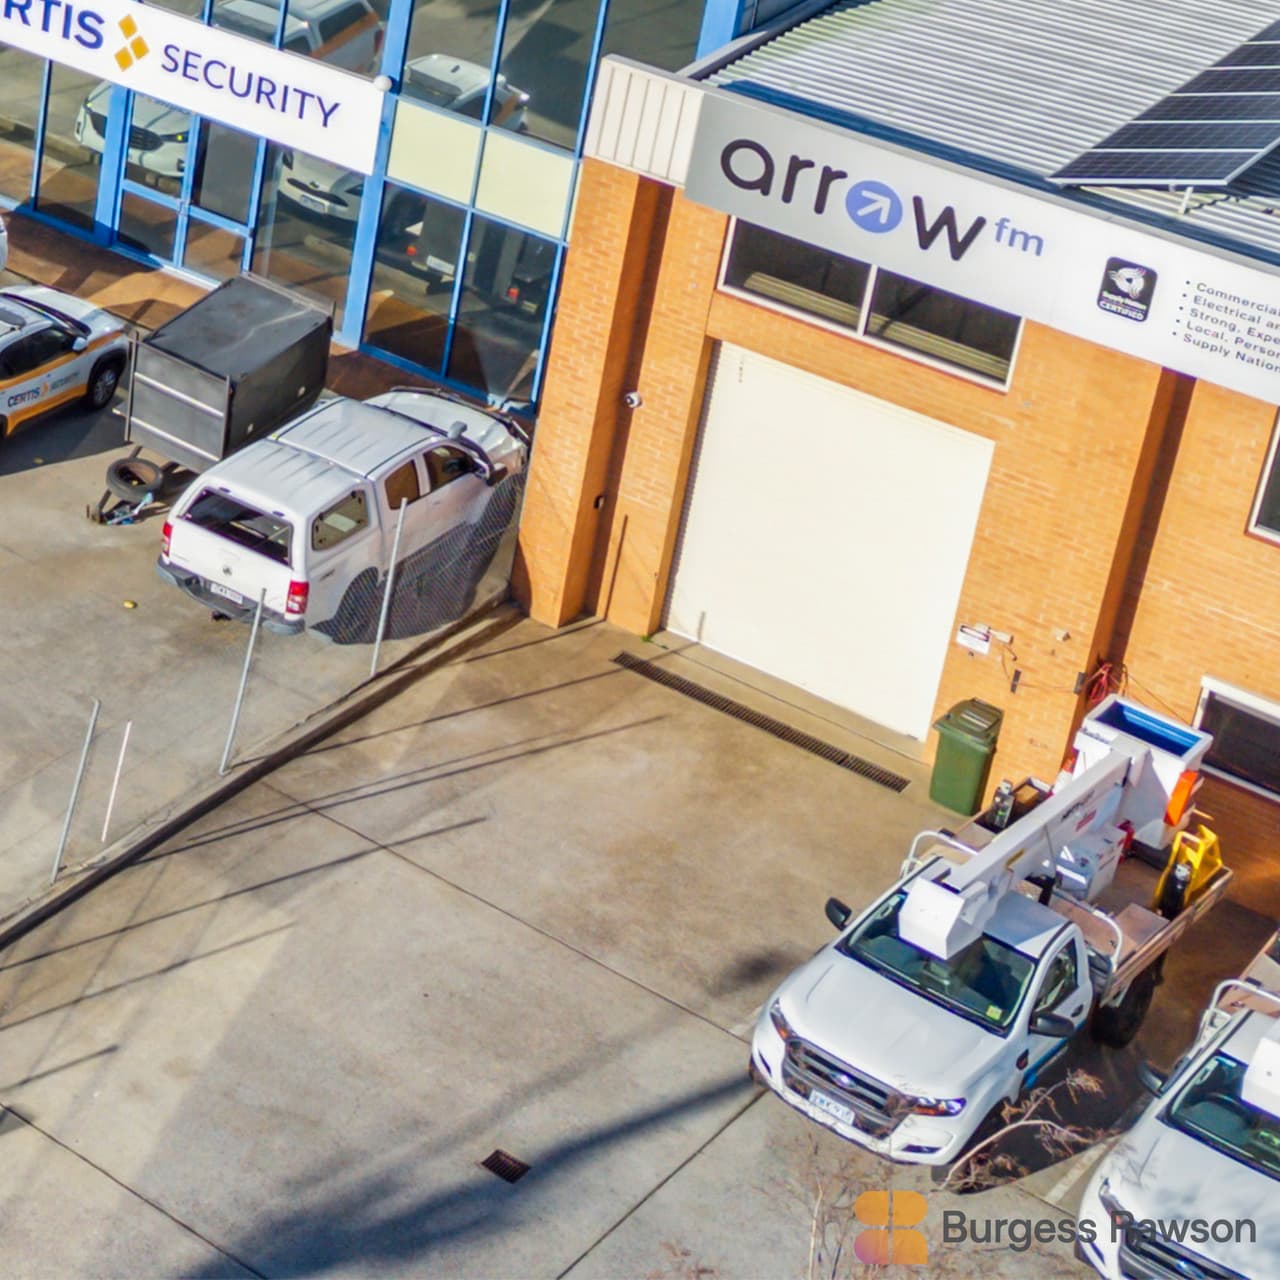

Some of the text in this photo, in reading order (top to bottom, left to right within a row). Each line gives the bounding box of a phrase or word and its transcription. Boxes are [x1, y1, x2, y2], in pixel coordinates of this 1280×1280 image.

[161, 43, 341, 128] SECURITY
[994, 217, 1045, 257] fm
[1193, 295, 1261, 324] Electrical
[1183, 334, 1231, 358] Supply
